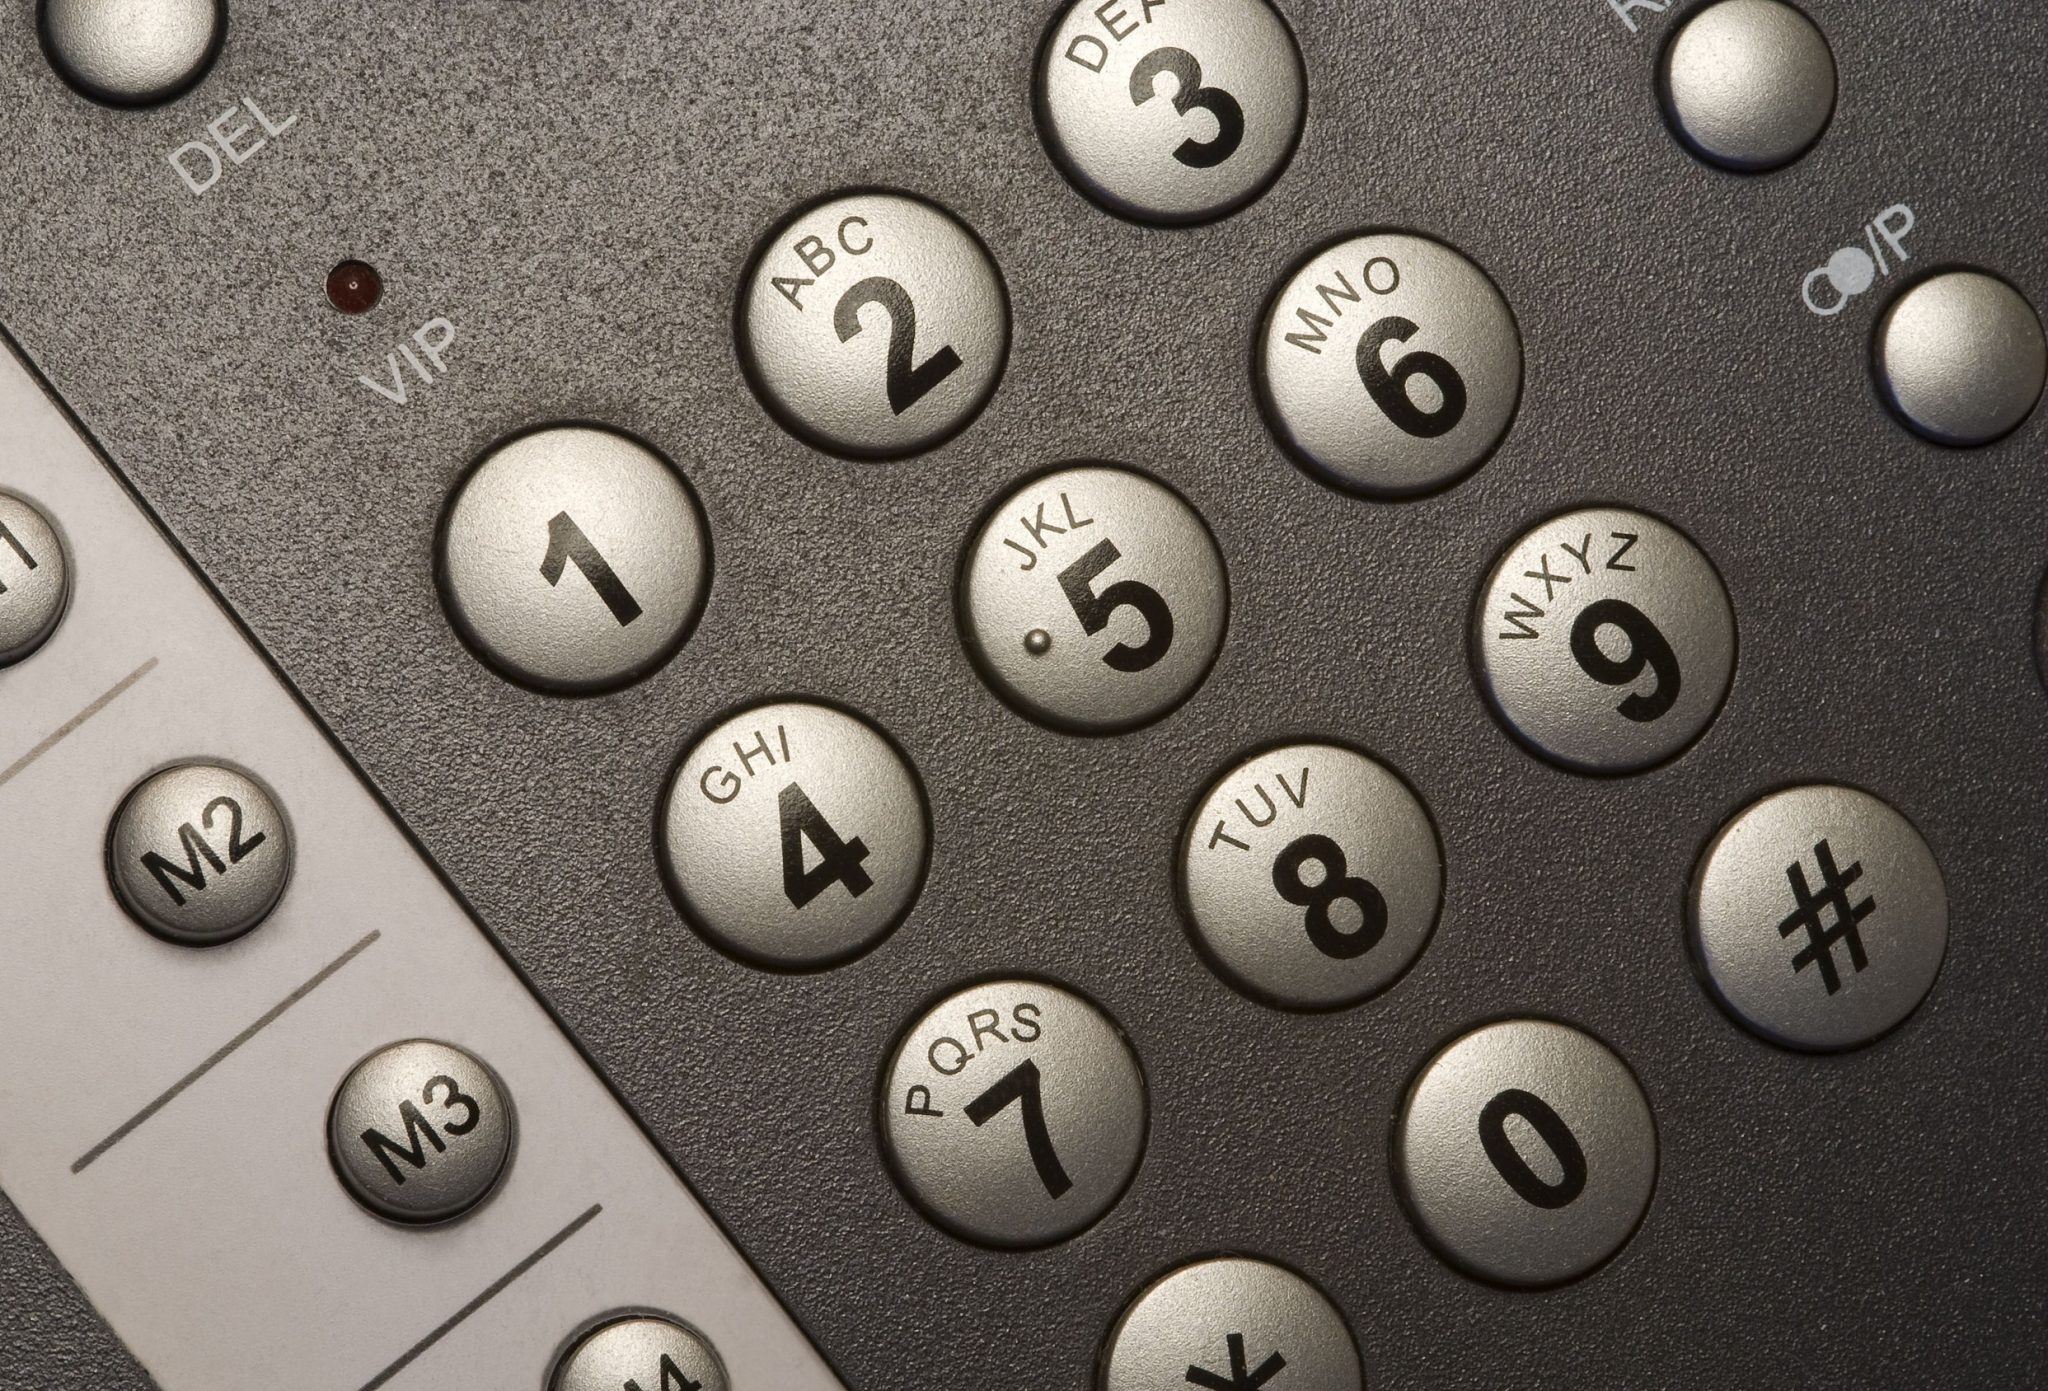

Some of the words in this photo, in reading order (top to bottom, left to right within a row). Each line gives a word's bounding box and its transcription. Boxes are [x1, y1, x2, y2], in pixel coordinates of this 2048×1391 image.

[168, 97, 298, 196] DEL
[1129, 46, 1245, 169] 3
[771, 215, 874, 311] ABC
[1284, 256, 1400, 355] MNO
[358, 317, 456, 406] VIP
[833, 276, 963, 416] 2
[1355, 315, 1467, 438] 6
[539, 510, 643, 627] 1
[1003, 493, 1093, 571] JKL
[1499, 531, 1638, 640] WXYZ
[1056, 537, 1174, 673] 5
[1570, 598, 1681, 723] 9
[700, 725, 791, 804] GHI
[1208, 767, 1309, 852] TUV
[140, 796, 266, 906] M2
[778, 781, 874, 910] 4
[1272, 834, 1388, 959] 8
[1777, 838, 1876, 996] #
[905, 1002, 1041, 1116] PQRS
[360, 1074, 481, 1186] M3
[963, 1058, 1073, 1199] 7
[1479, 1088, 1588, 1210] 0
